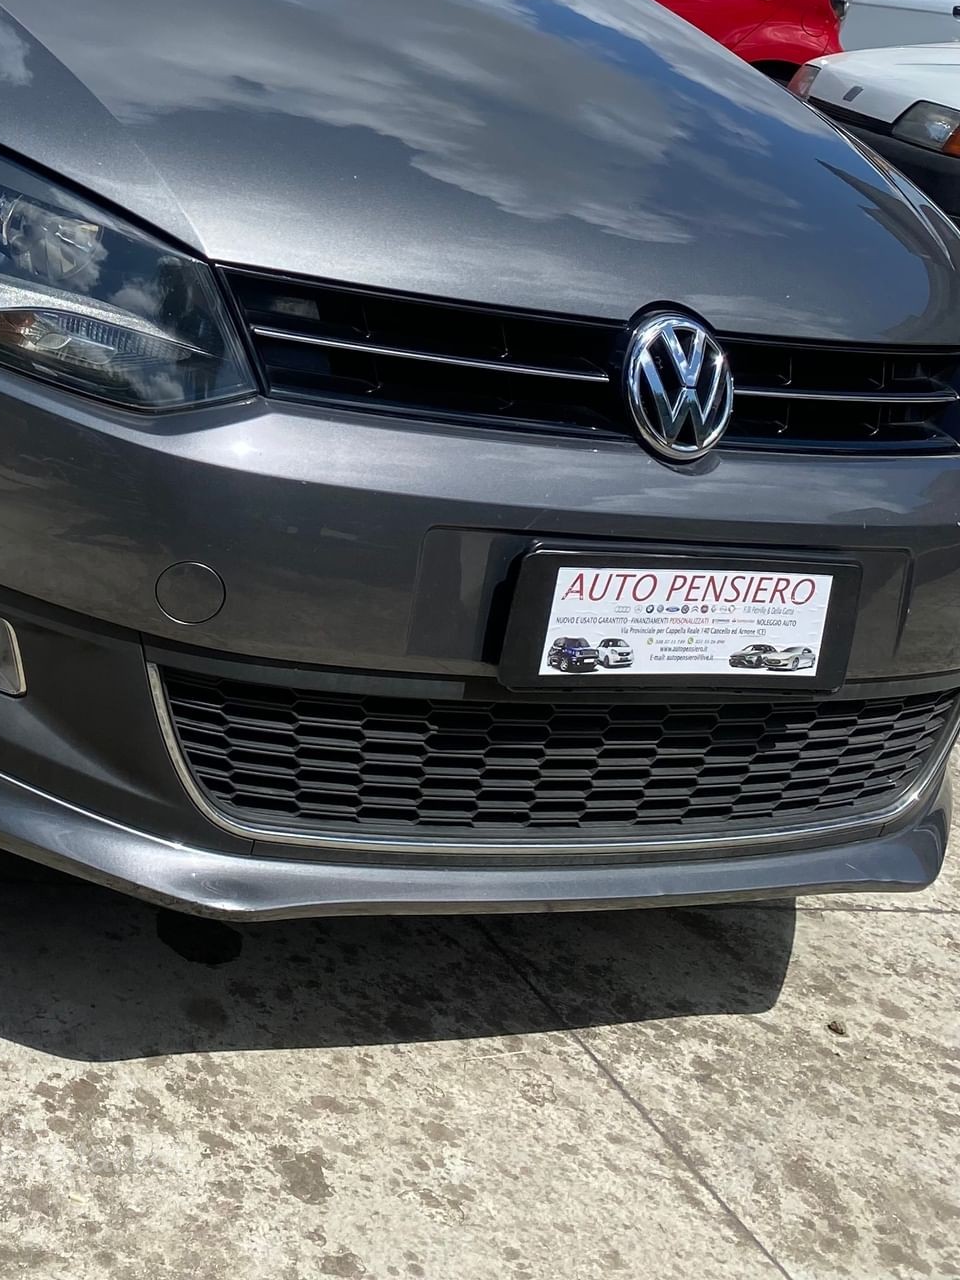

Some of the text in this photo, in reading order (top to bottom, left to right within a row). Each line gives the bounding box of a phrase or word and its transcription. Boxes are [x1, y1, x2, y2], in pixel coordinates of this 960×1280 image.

[561, 573, 816, 605] AUTO PENSIERO
[630, 617, 669, 625] FINANZIAMENTI
[665, 627, 686, 635] Cappella
[710, 627, 730, 635] Cancello
